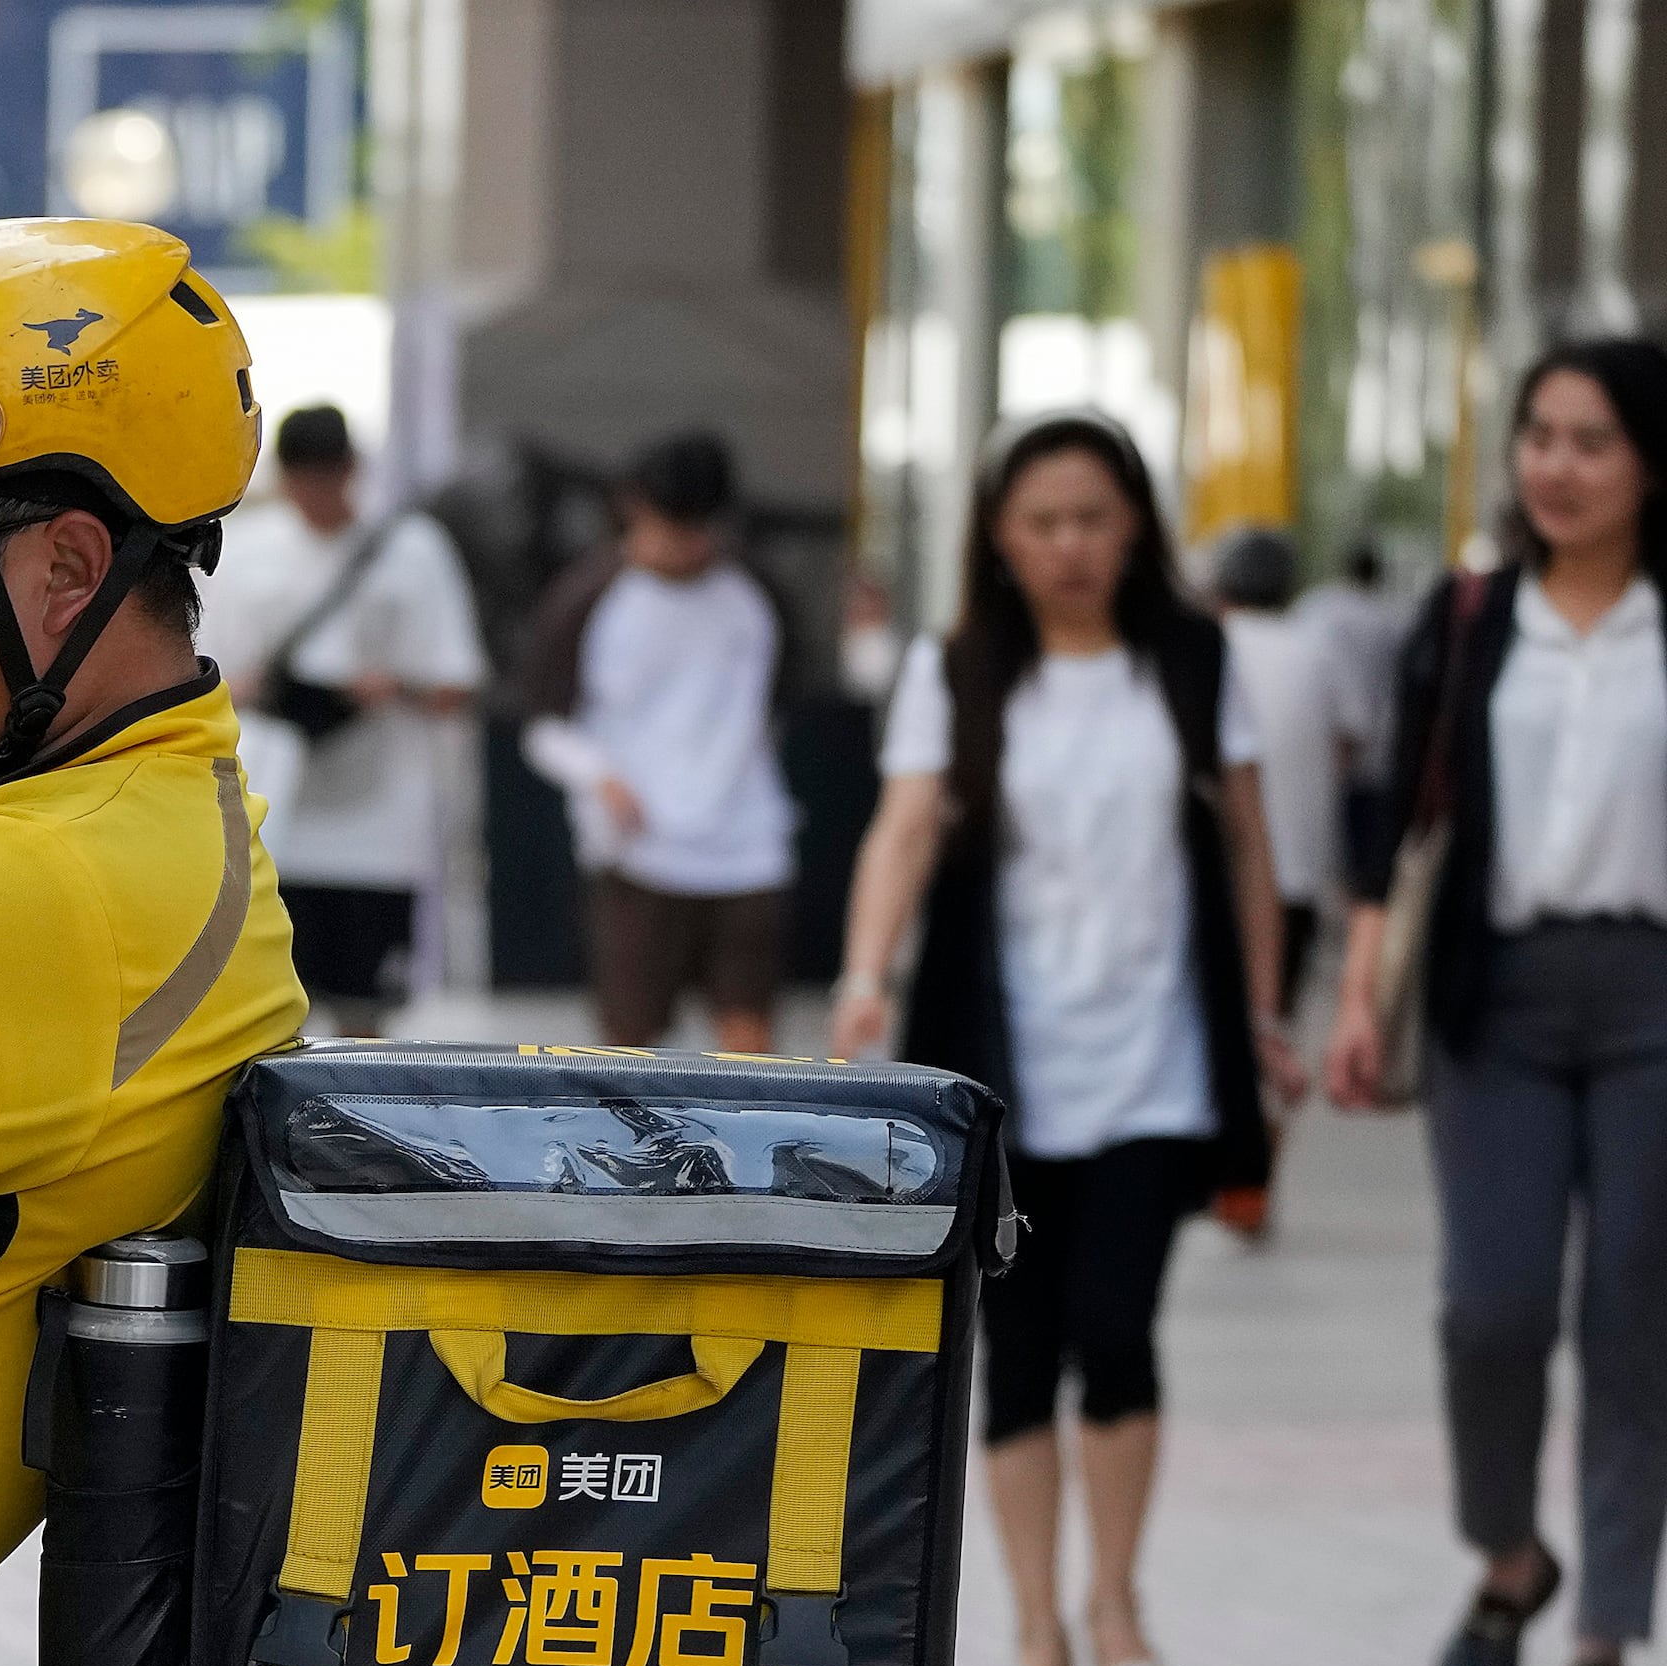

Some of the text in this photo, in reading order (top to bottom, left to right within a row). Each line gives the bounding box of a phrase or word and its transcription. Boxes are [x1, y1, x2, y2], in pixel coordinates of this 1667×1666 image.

[20, 359, 120, 391] 美团外卖
[489, 1452, 663, 1503] 美团 美团
